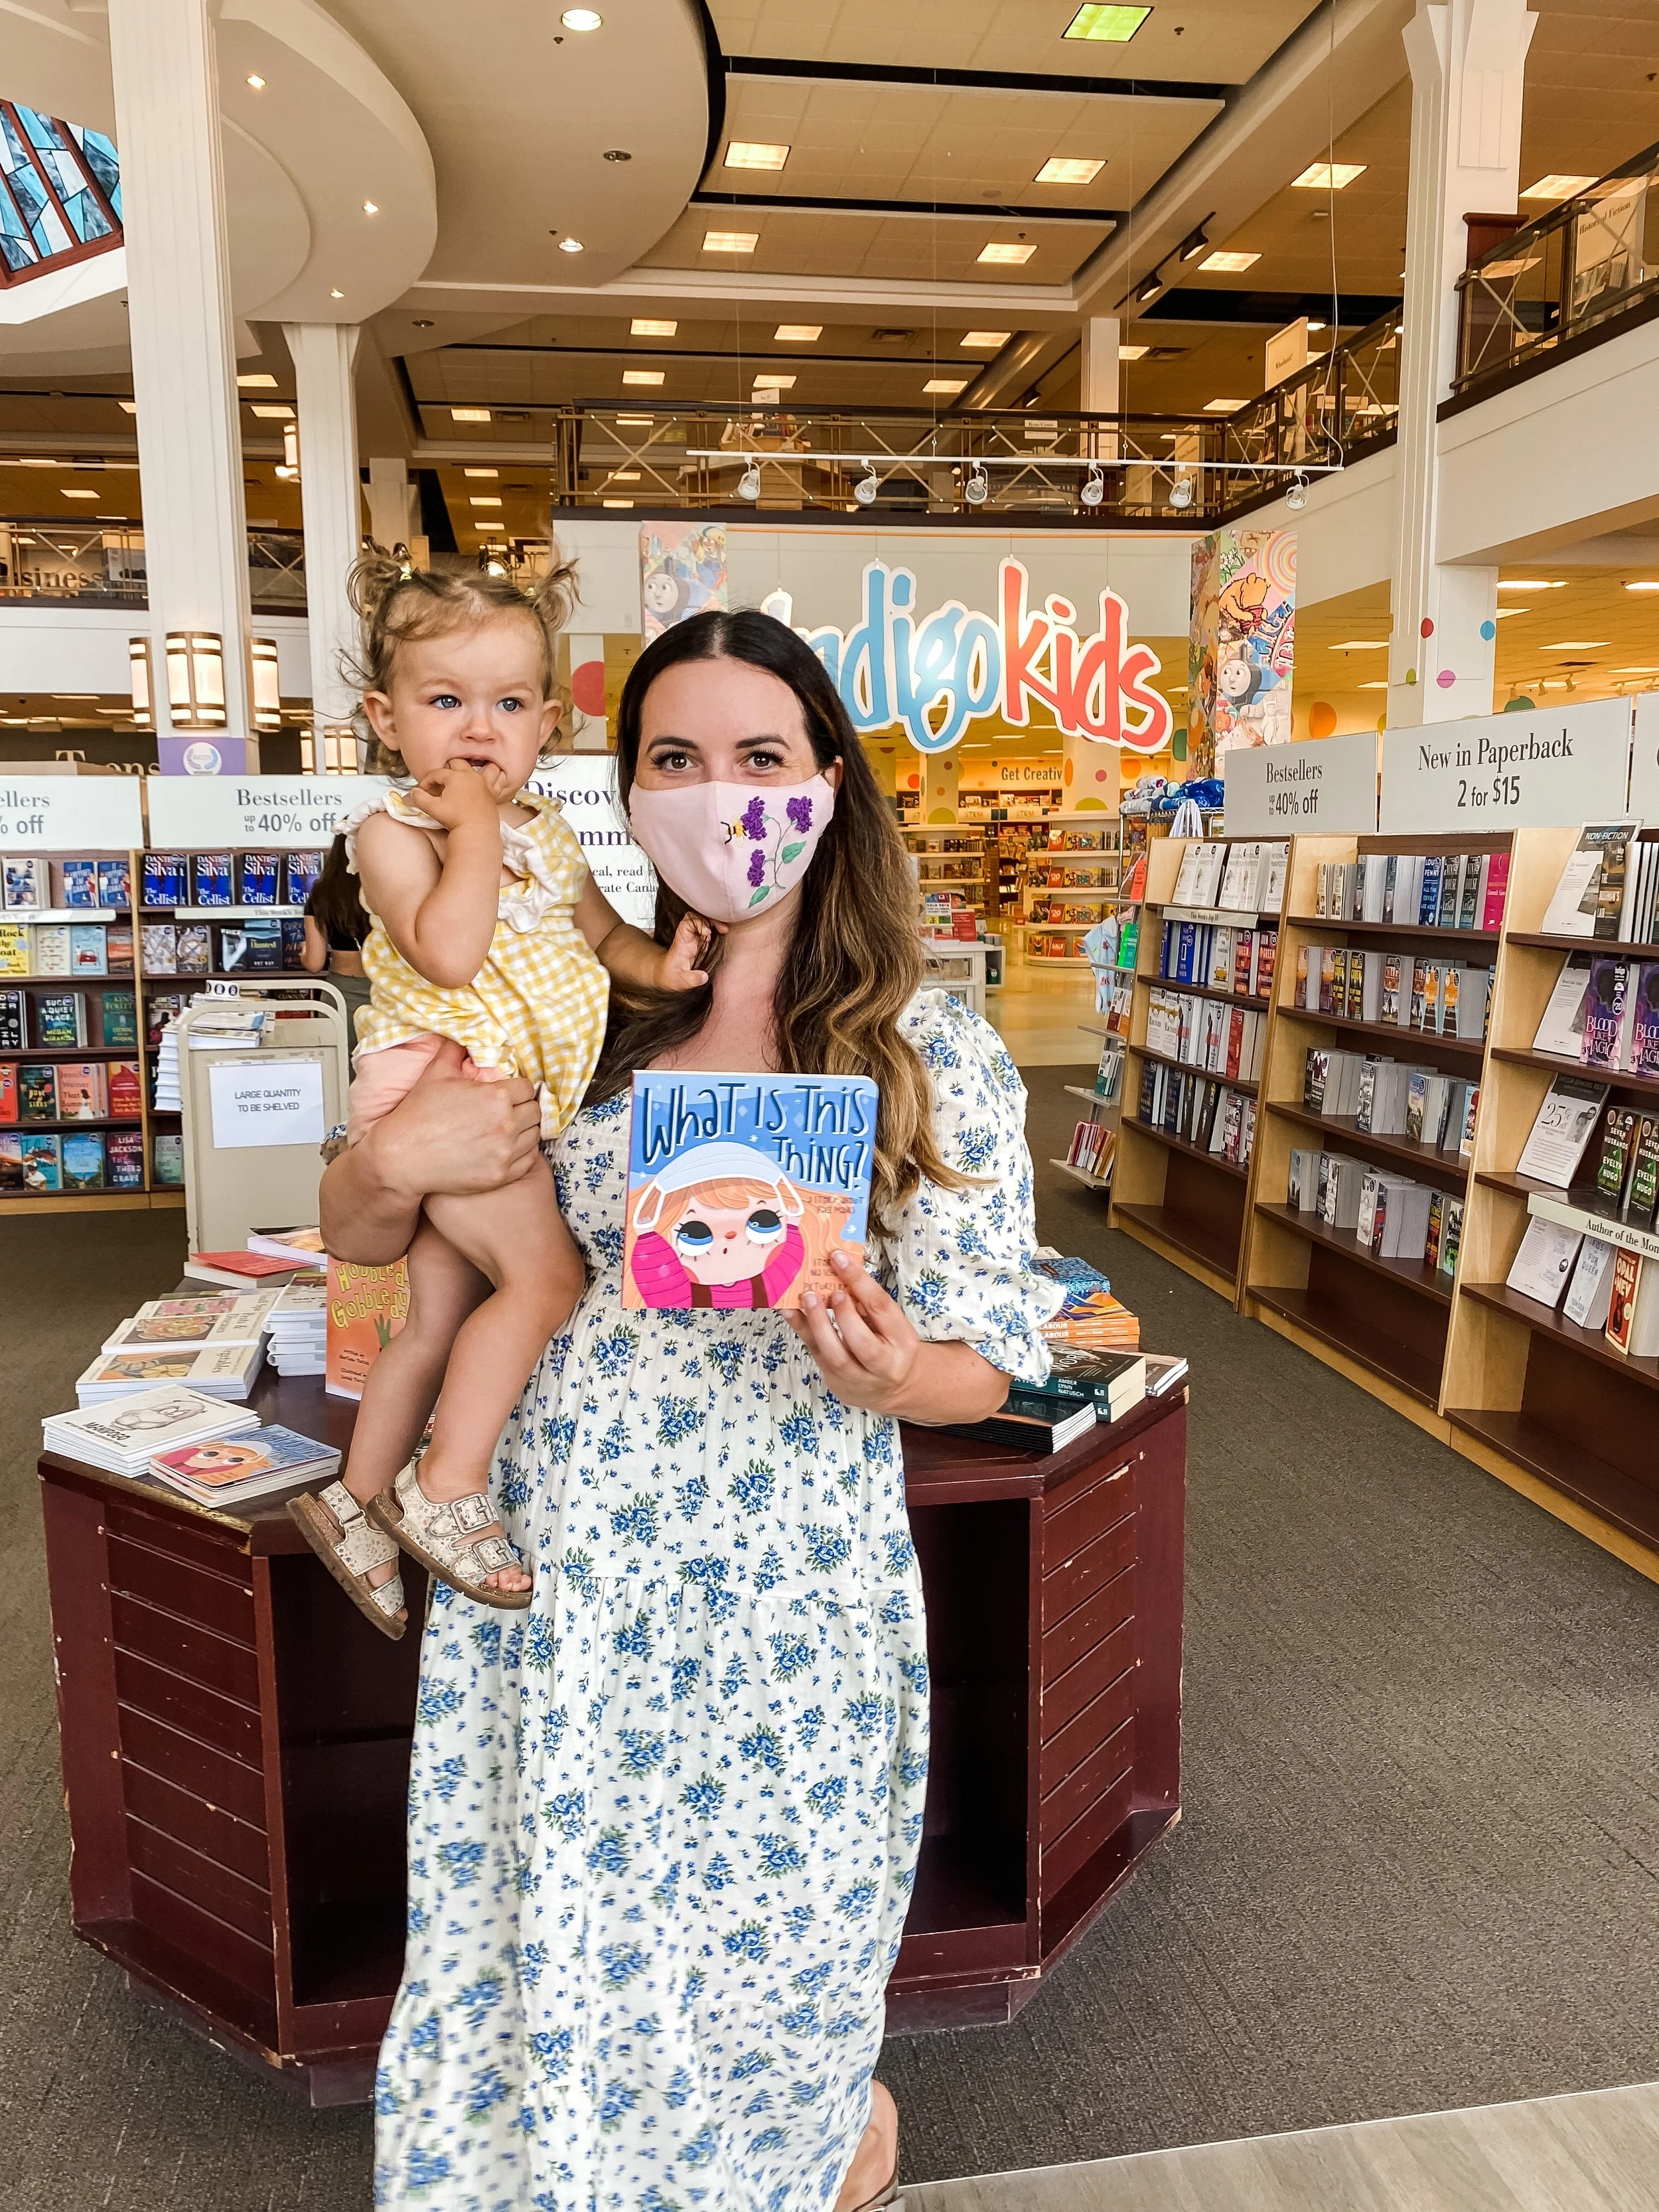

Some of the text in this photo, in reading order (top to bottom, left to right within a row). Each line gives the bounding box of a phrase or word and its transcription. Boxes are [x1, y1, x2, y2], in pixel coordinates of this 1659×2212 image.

[1418, 728, 1574, 774] New in Paperback
[1001, 767, 1062, 780] Get Creativ
[1265, 759, 1323, 783] Bestsellers
[236, 788, 342, 806] Bestsellers
[1457, 775, 1520, 808] 2 for $15
[0, 790, 50, 808] ellers
[1275, 790, 1299, 816] 40%
[1303, 788, 1319, 814] off
[17, 814, 44, 834] off
[244, 815, 256, 824] up
[258, 813, 303, 832] 40%
[309, 812, 336, 832] off
[1585, 832, 1630, 840] NON-FICTION
[145, 862, 178, 876] Silva
[196, 862, 229, 876] Silva
[244, 861, 275, 875] Silva
[288, 861, 319, 875] Silva
[593, 865, 643, 878] cal, read
[144, 893, 178, 905] Cellist
[198, 893, 230, 905] Cellist
[242, 892, 275, 903] Cellist
[289, 892, 310, 903] Cell
[1586, 1015, 1618, 1037] BLOOD
[1635, 1023, 1659, 1041] BLOO
[1593, 1031, 1607, 1041] LIKE
[235, 1089, 301, 1100] LARGE QUANTITY
[263, 1102, 299, 1111] SHELVED
[1610, 1128, 1626, 1140] SEVEN
[1604, 1136, 1628, 1150] HUSBANDS
[1603, 1156, 1623, 1169] EVELYN
[1603, 1169, 1618, 1181] HUGO
[1637, 1169, 1657, 1183] EVELYN
[1636, 1182, 1652, 1195] HUGO
[1585, 1219, 1659, 1254] Author of the Mon
